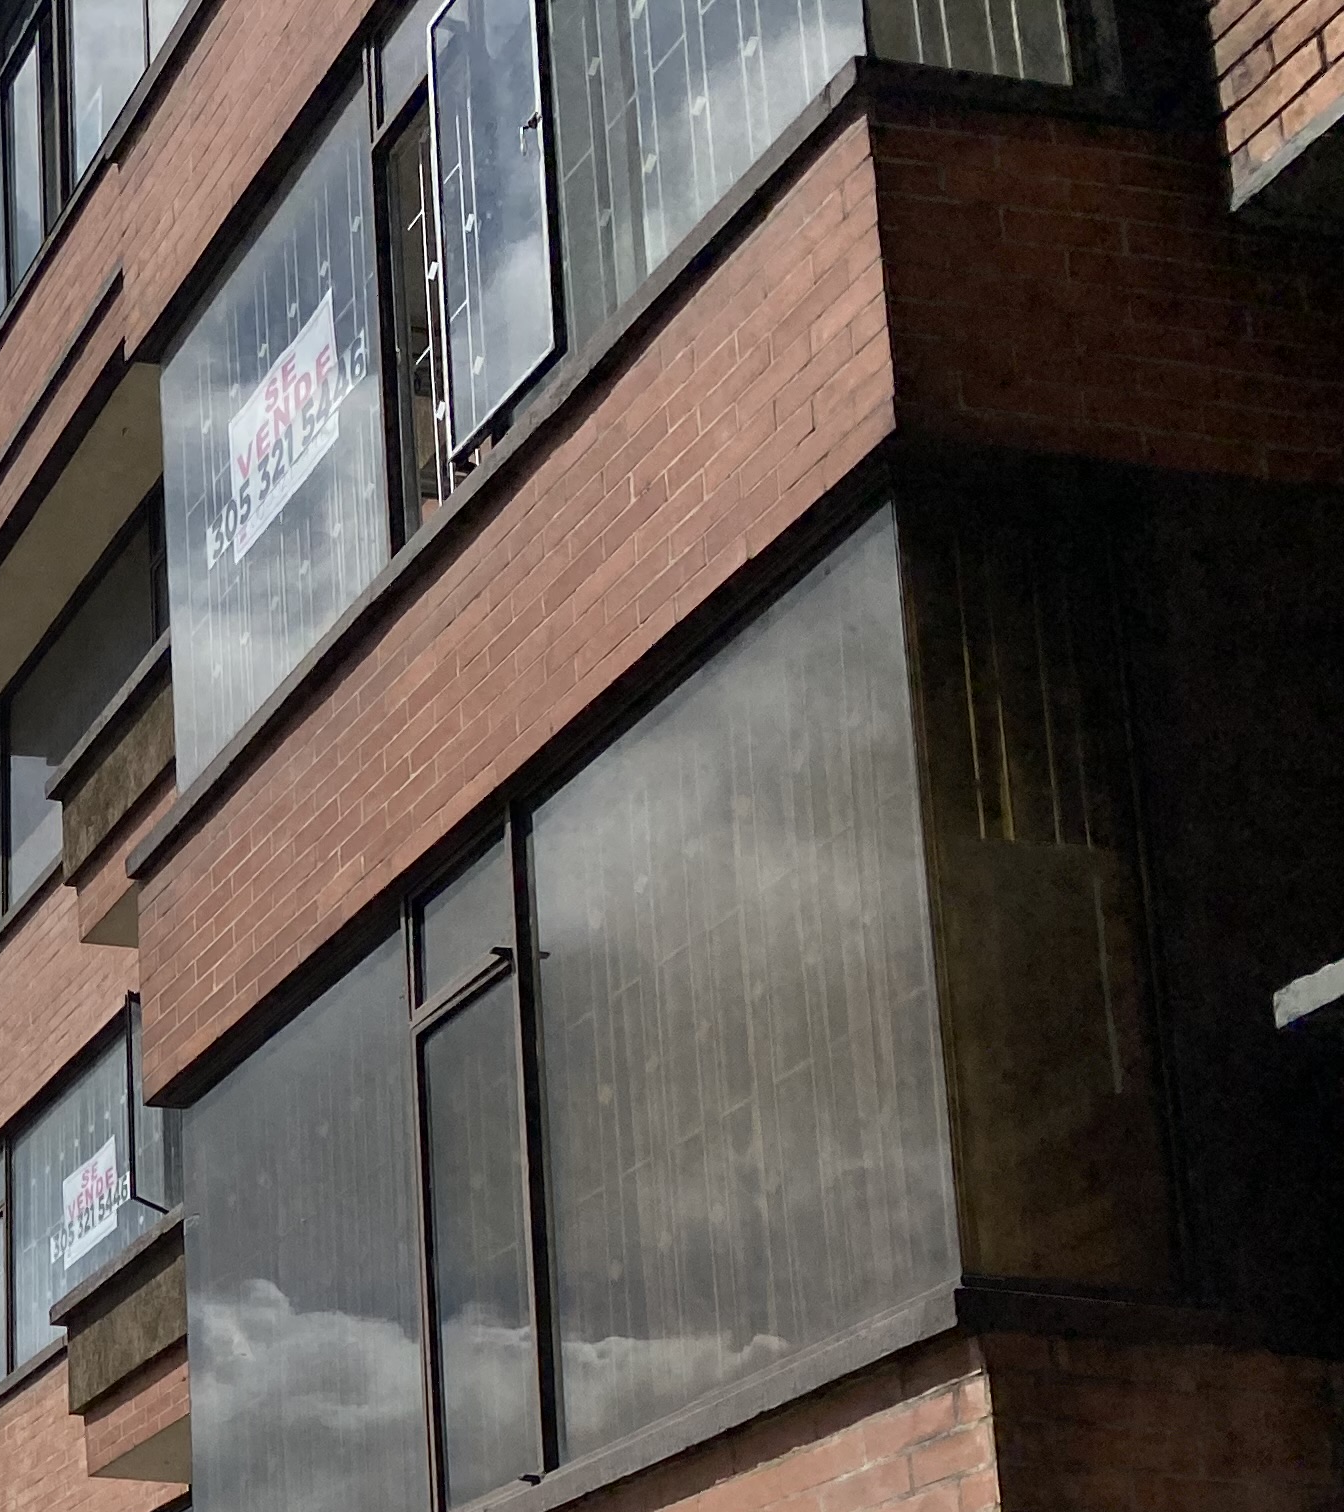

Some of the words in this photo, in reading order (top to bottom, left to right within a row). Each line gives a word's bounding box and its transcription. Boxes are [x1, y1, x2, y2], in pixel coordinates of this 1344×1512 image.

[236, 343, 332, 480] VENDE
[264, 352, 297, 414] SE
[211, 477, 252, 560] 305
[257, 423, 295, 502] 321
[300, 336, 365, 448] 5446
[67, 1166, 115, 1220] VENDE
[81, 1160, 99, 1189] SE
[53, 1220, 75, 1259] 305
[77, 1204, 95, 1239] 321
[98, 1173, 128, 1221] 5446
